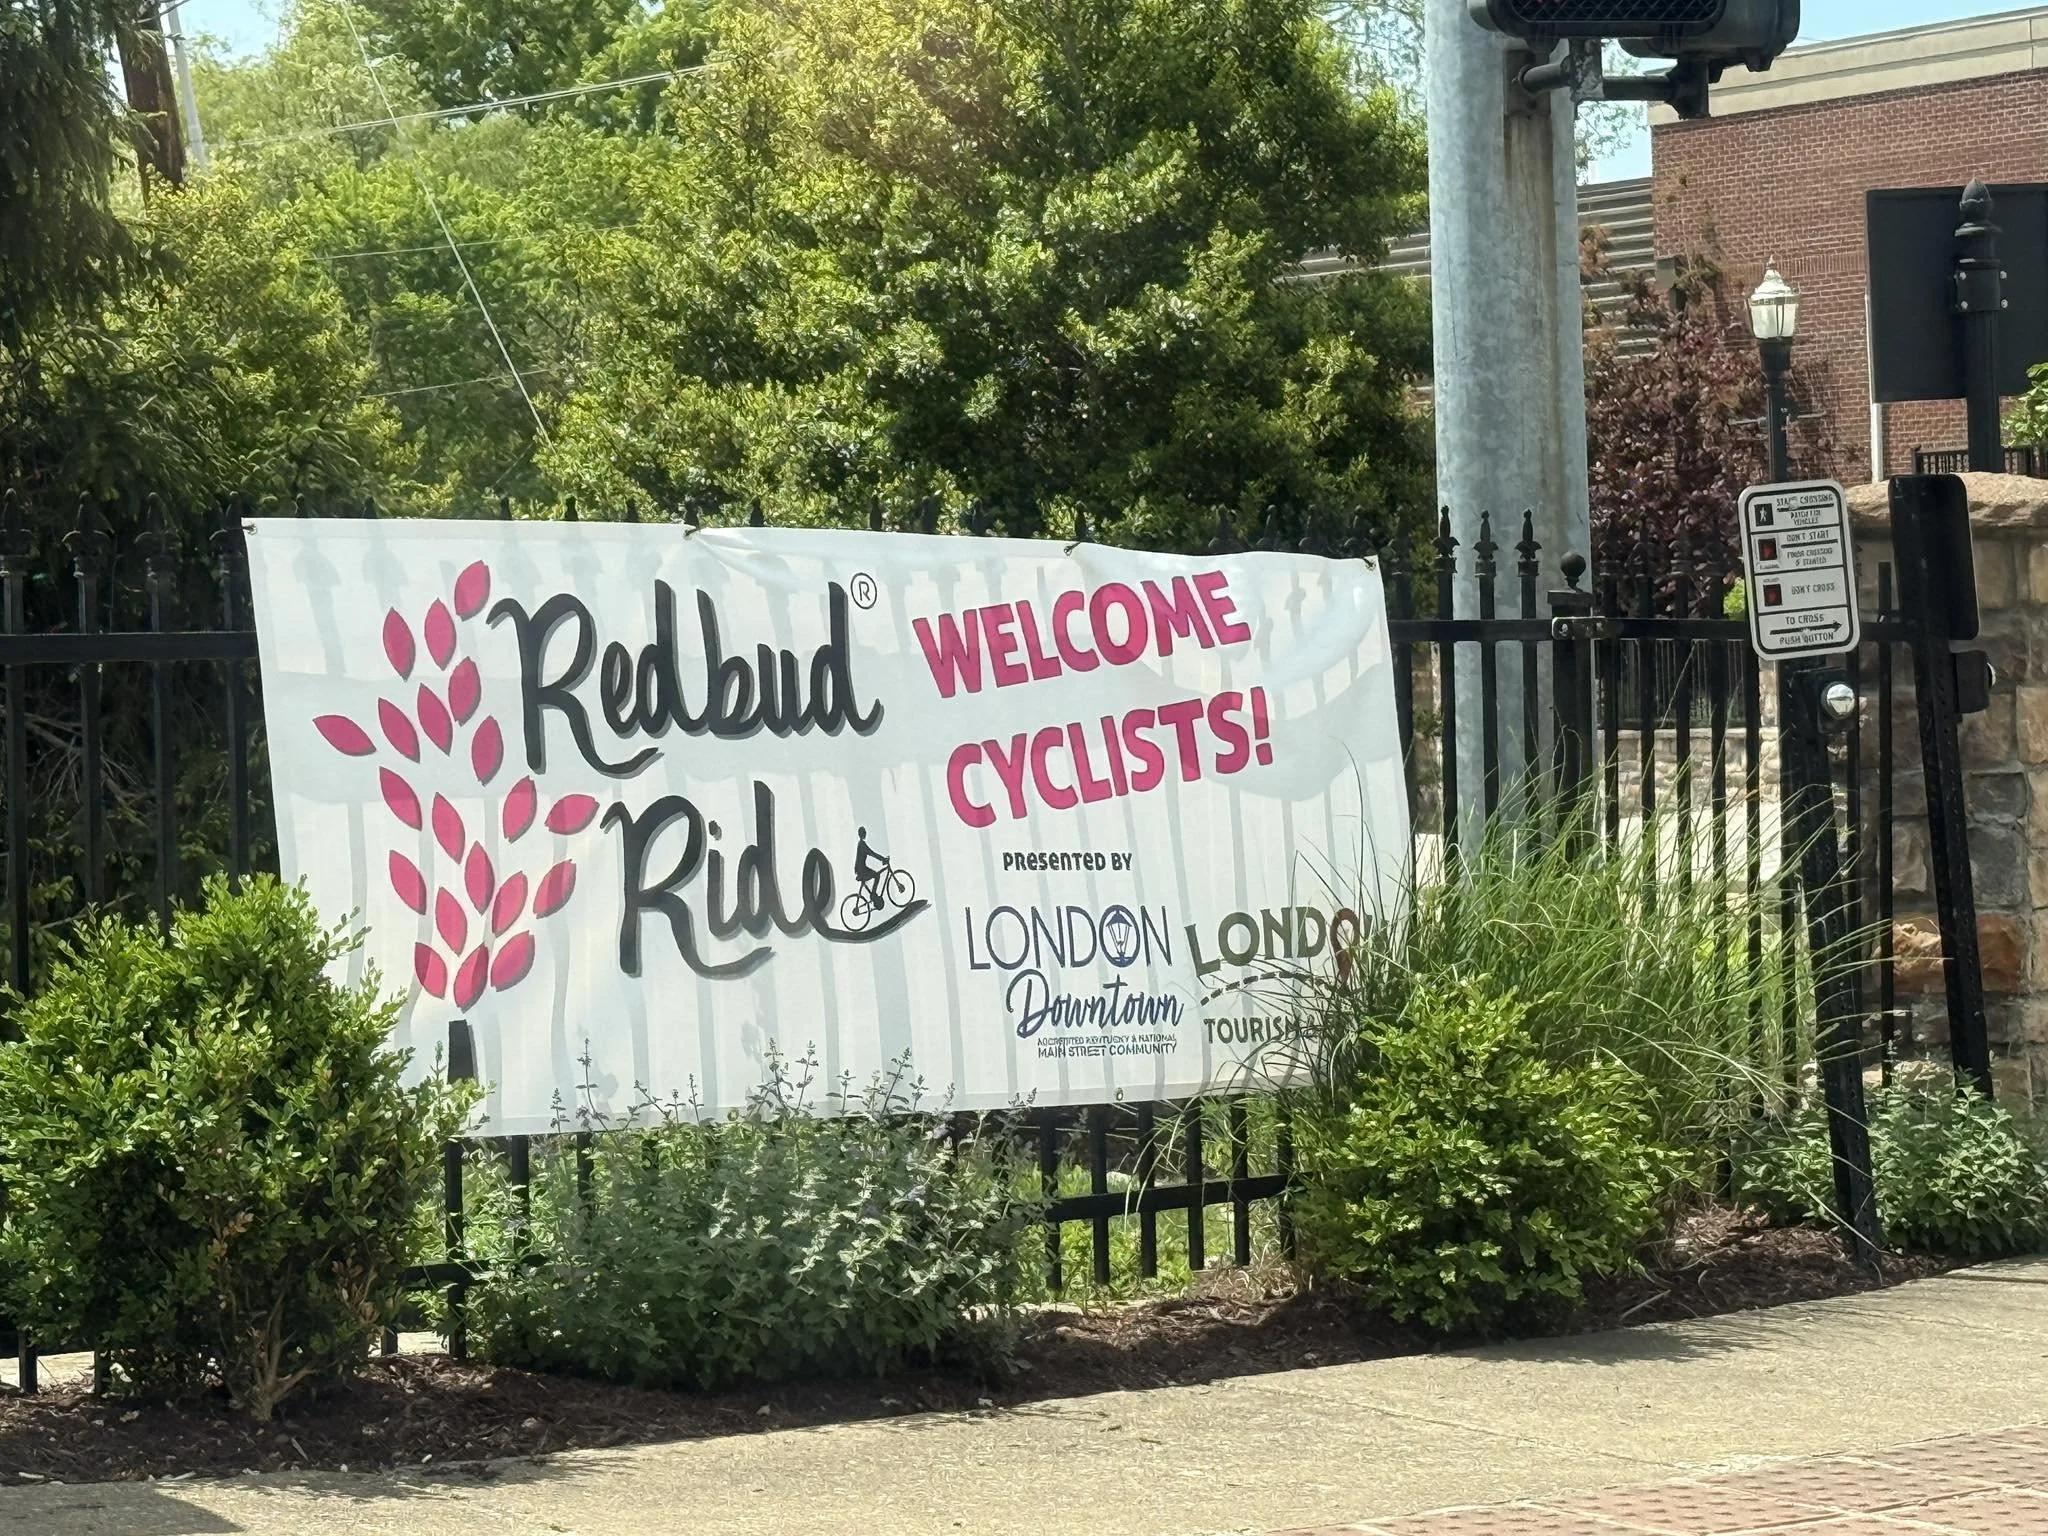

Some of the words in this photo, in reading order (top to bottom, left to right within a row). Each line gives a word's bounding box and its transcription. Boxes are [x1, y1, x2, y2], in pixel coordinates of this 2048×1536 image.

[1776, 496, 1797, 506] STA
[912, 570, 1251, 698] WELCOME
[1785, 616, 1796, 625] TO
[1798, 613, 1824, 624] CROSS
[947, 686, 1273, 828] CYCLISTS!
[600, 780, 931, 980] Ride
[1111, 852, 1132, 871] BY
[965, 905, 1173, 970] LONDON
[1006, 968, 1184, 1039] Downtown
[1109, 1042, 1177, 1056] COMMUNITY
